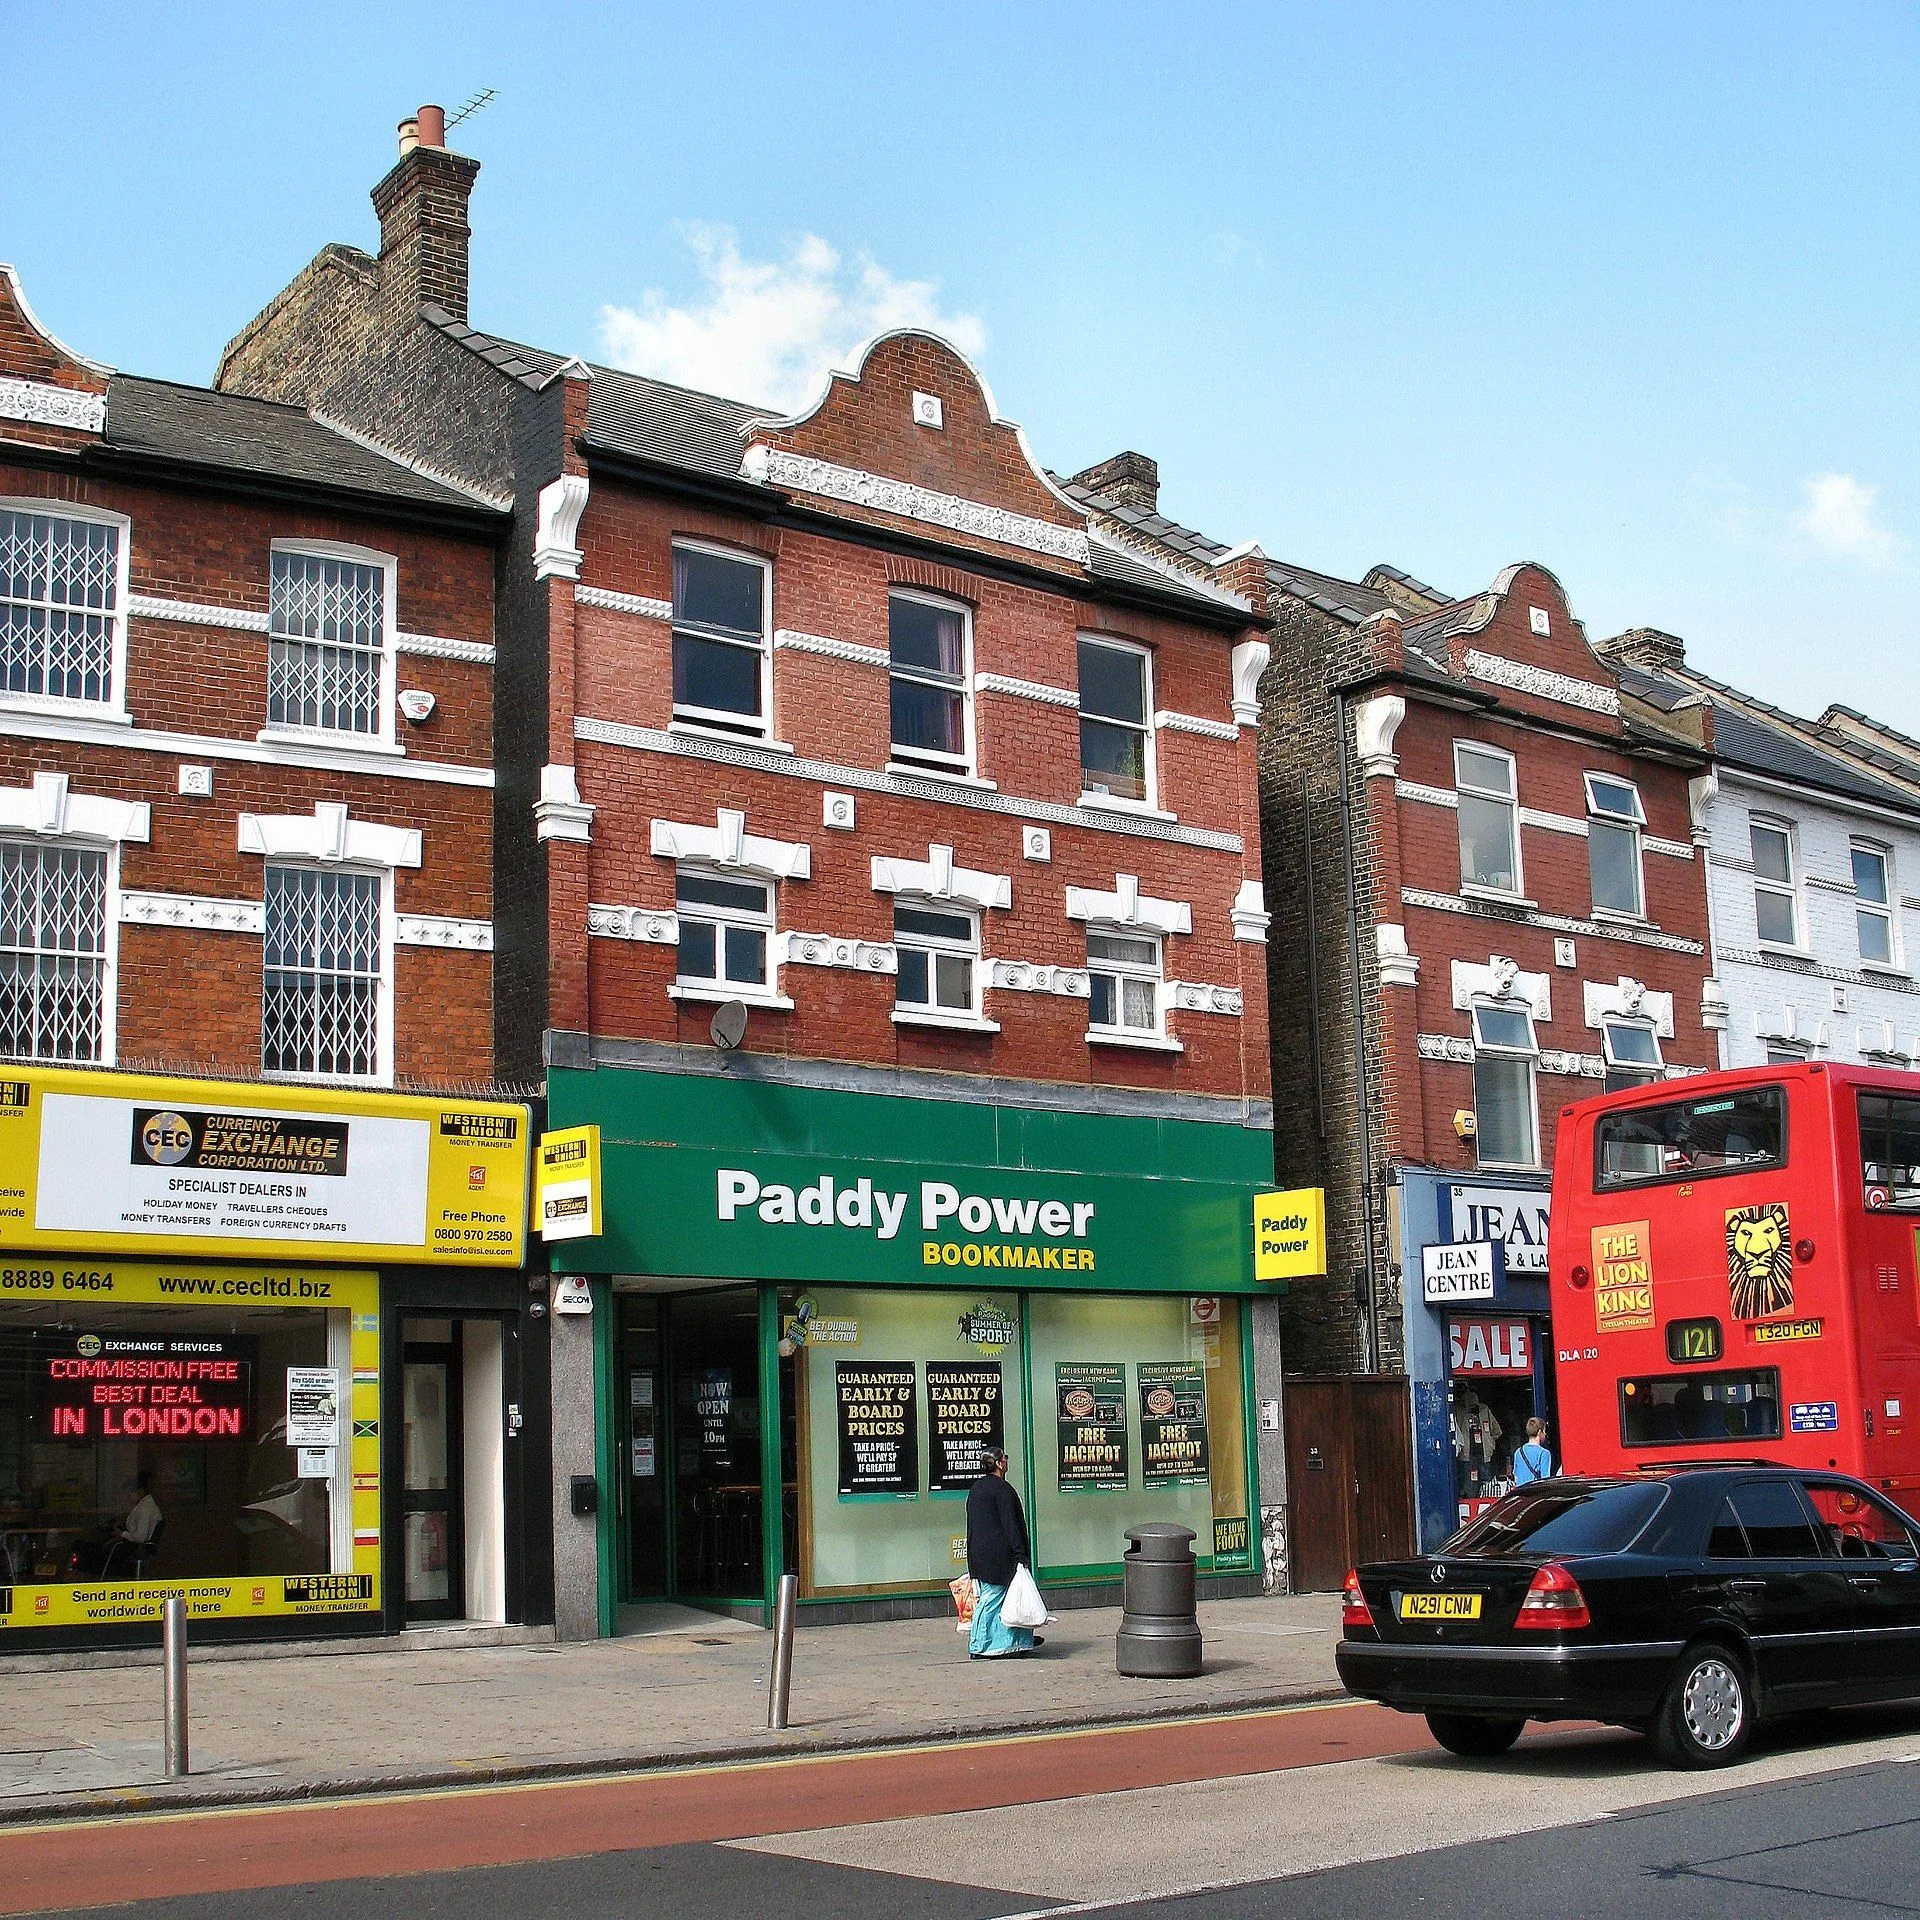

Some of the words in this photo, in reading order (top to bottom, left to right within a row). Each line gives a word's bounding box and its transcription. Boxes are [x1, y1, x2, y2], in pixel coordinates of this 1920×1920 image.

[0, 1109, 24, 1117] SFER
[206, 1116, 282, 1132] CURRENCY
[442, 1114, 506, 1127] WESTERN
[145, 1129, 191, 1148] CEC
[461, 1126, 505, 1138] UNION
[202, 1131, 340, 1158] EXCHANGE
[449, 1139, 475, 1148] MONEY
[477, 1140, 513, 1149] TRANSFER
[544, 1141, 579, 1155] WESTERN
[199, 1154, 298, 1171] CORPORATION
[300, 1160, 329, 1173] LTD.
[554, 1151, 579, 1162] UNION
[169, 1179, 237, 1194] SPECIALIST
[240, 1183, 293, 1197] DEALERS
[296, 1186, 307, 1198] IN
[1454, 1188, 1463, 1196] 35
[143, 1199, 183, 1209] HOLIDAY
[185, 1201, 217, 1211] MONEY
[227, 1203, 284, 1214] TRAVELLERS
[286, 1206, 328, 1216] CHEQUES
[717, 1168, 908, 1239] Paddy
[921, 1182, 1095, 1237] Power
[121, 1213, 155, 1223] MONEY
[157, 1215, 211, 1226] TRANSFERS
[221, 1218, 260, 1228] FOREIGN
[262, 1220, 311, 1230] CURRENCY
[313, 1222, 347, 1232] DRAFTS
[442, 1210, 468, 1222] Free
[471, 1211, 506, 1223] Phone
[1261, 1214, 1308, 1237] Paddy
[434, 1229, 461, 1240] 0800
[463, 1229, 484, 1241] 970
[486, 1230, 512, 1242] 2580
[1261, 1238, 1309, 1255] Power
[1600, 1233, 1637, 1258] THE
[922, 1240, 1096, 1271] BOOKMAKER
[1437, 1250, 1477, 1270] JEAN
[1517, 1253, 1525, 1267] &
[1531, 1253, 1549, 1267] LA
[1598, 1262, 1649, 1284] LION
[2, 1270, 54, 1289] 8889
[63, 1271, 114, 1290] 6464
[158, 1276, 331, 1298] www.cecltd.biz
[1427, 1272, 1491, 1294] CENTRE
[563, 1295, 589, 1303] SECOM
[1598, 1288, 1650, 1313] KING
[810, 1322, 826, 1331] BET
[828, 1322, 857, 1331] DURING
[971, 1320, 1000, 1328] SUMMER
[1624, 1318, 1649, 1327] THEATRE
[812, 1332, 827, 1341] THE
[829, 1332, 858, 1341] ACTION
[971, 1328, 1011, 1342] SPORT
[1757, 1322, 1790, 1340] T320
[1794, 1320, 1819, 1336] FGN
[78, 1340, 100, 1350] CEC
[105, 1341, 164, 1351] EXCHANGE
[170, 1342, 223, 1352] SERVICES
[1450, 1325, 1527, 1368] SALE
[1684, 1327, 1714, 1357] 121
[1559, 1349, 1580, 1362] DLA
[1583, 1347, 1598, 1360] 120
[51, 1360, 183, 1379] COMMISSION
[187, 1361, 239, 1379] FREE
[838, 1373, 914, 1384] GUARANTEED
[928, 1373, 1000, 1384] GUARANTEED
[93, 1385, 146, 1403] BEST
[152, 1386, 203, 1403] DEAL
[700, 1382, 728, 1397] NOW
[842, 1387, 894, 1401] EARLY
[897, 1388, 910, 1401] &
[932, 1387, 981, 1400] EARLY
[985, 1387, 996, 1400] &
[697, 1400, 729, 1414] OPEN
[848, 1405, 903, 1418] BOARD
[938, 1404, 990, 1417] BOARD
[53, 1408, 85, 1434] IN
[104, 1408, 240, 1435] LONDON
[704, 1419, 723, 1427] UNTIL
[848, 1422, 904, 1435] PRICES
[938, 1421, 991, 1434] PRICES
[1077, 1428, 1107, 1444] FREE
[1159, 1425, 1188, 1441] FREE
[853, 1443, 870, 1451] TAKE
[876, 1442, 894, 1450] PRICE
[943, 1441, 958, 1450] TAKE
[1148, 1441, 1202, 1461] JACKPOT
[857, 1453, 875, 1462] WE'LL
[876, 1453, 887, 1462] PAY
[888, 1452, 897, 1461] SP
[946, 1451, 964, 1460] WE'LL
[965, 1451, 975, 1460] PAY
[1064, 1446, 1121, 1463] JACKPOT
[859, 1464, 865, 1473] IF
[948, 1462, 954, 1471] IF
[955, 1461, 980, 1470] GREATER
[1215, 1524, 1228, 1536] WE
[1228, 1521, 1246, 1534] LOVE
[1216, 1532, 1246, 1551] FOOTY
[953, 1549, 967, 1559] THE
[285, 1576, 358, 1590] WESTERN
[73, 1590, 106, 1602] Send
[110, 1589, 135, 1600] and
[139, 1587, 184, 1599] receive
[189, 1586, 231, 1598] money
[309, 1588, 357, 1600] UNION
[87, 1604, 155, 1617] worldwide
[193, 1602, 221, 1612] here
[295, 1603, 325, 1613] MONEY
[327, 1602, 368, 1611] TRANSFER
[1410, 1597, 1440, 1614] N291
[1444, 1597, 1472, 1614] CNM
